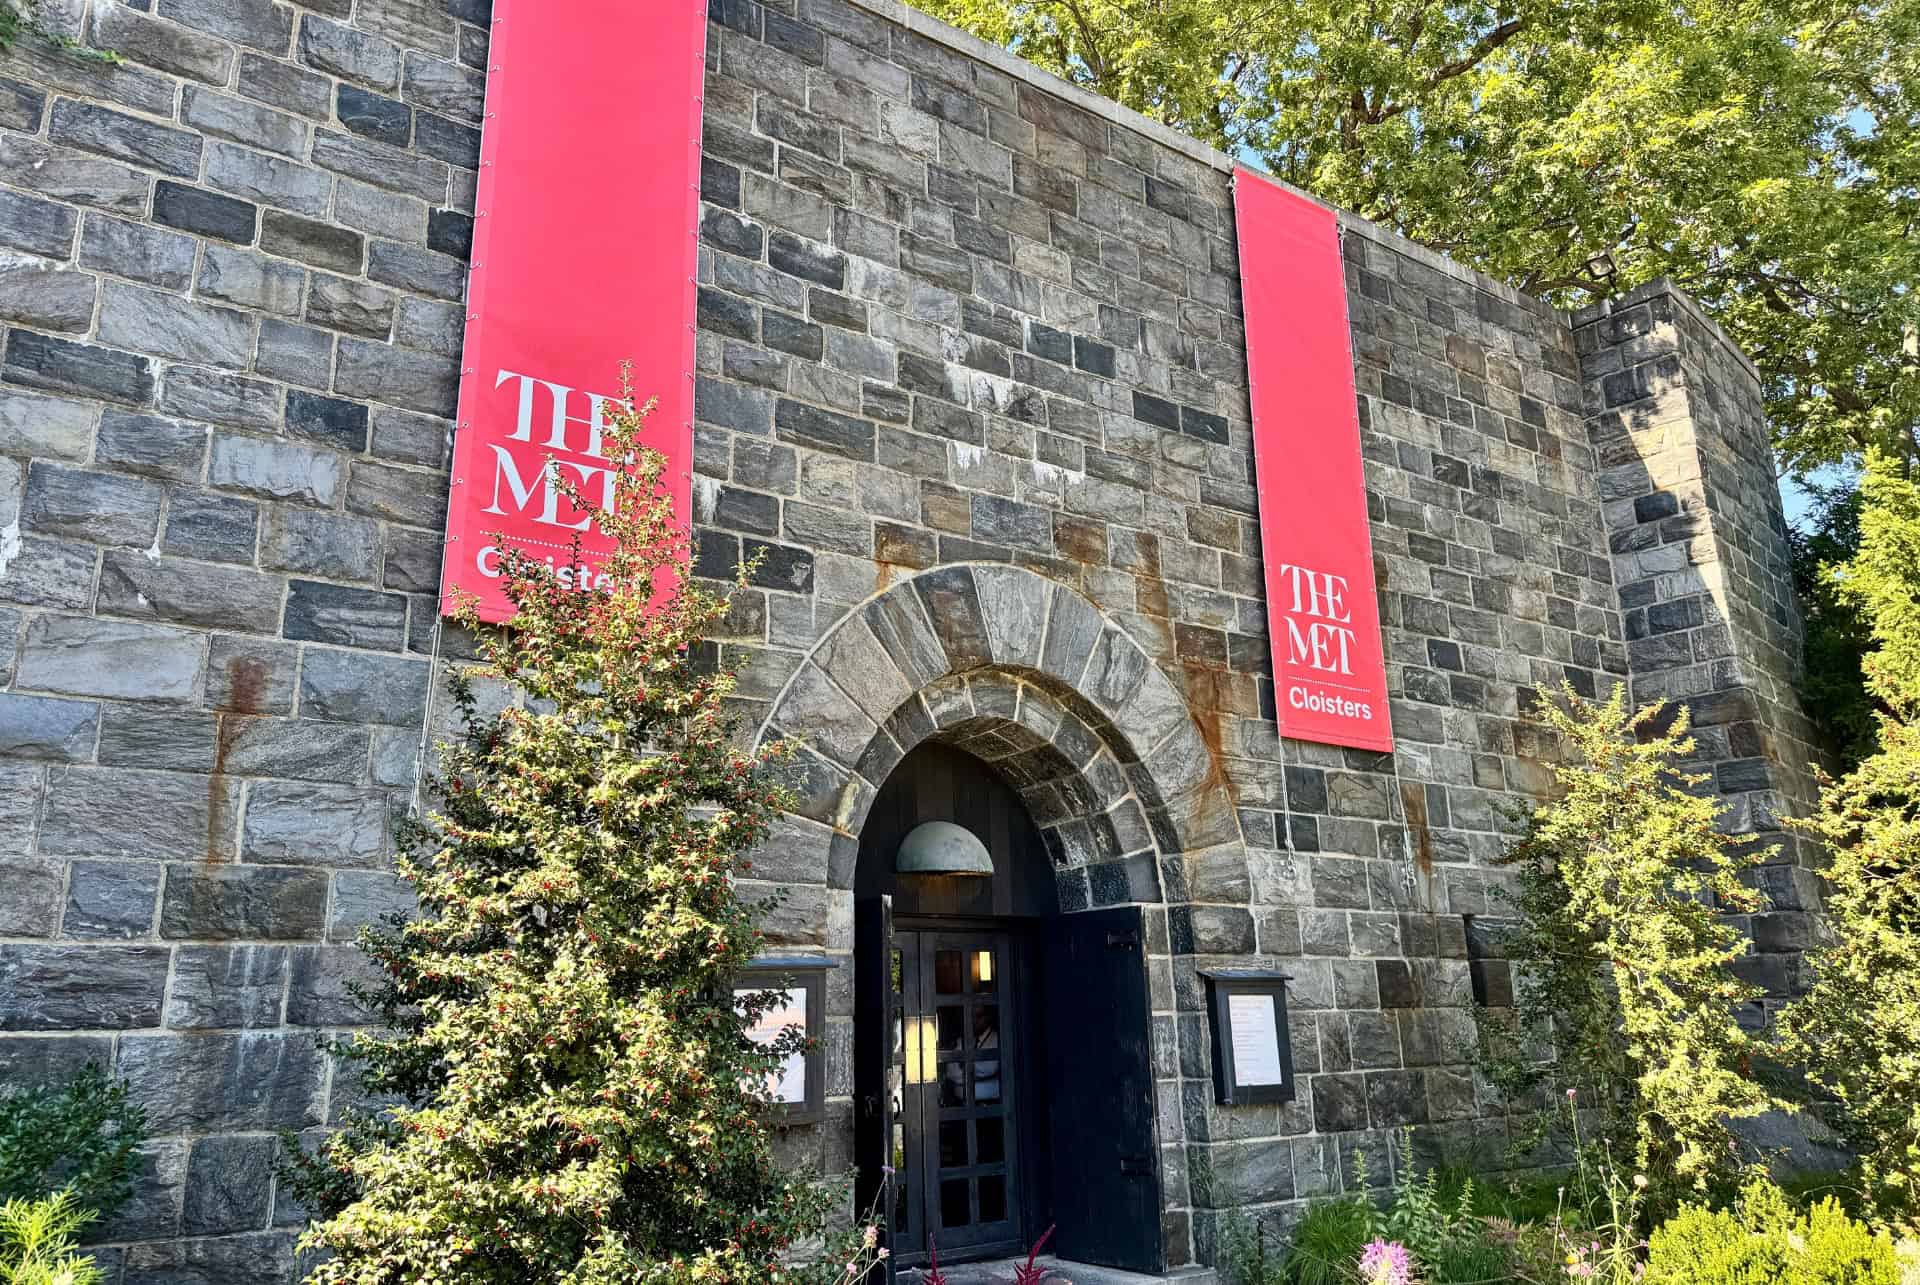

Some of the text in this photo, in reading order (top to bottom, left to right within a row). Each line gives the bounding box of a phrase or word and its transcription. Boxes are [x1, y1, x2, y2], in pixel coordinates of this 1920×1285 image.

[1281, 564, 1351, 624] THE
[1283, 616, 1358, 676] MET
[1289, 686, 1372, 720] Cloisters
